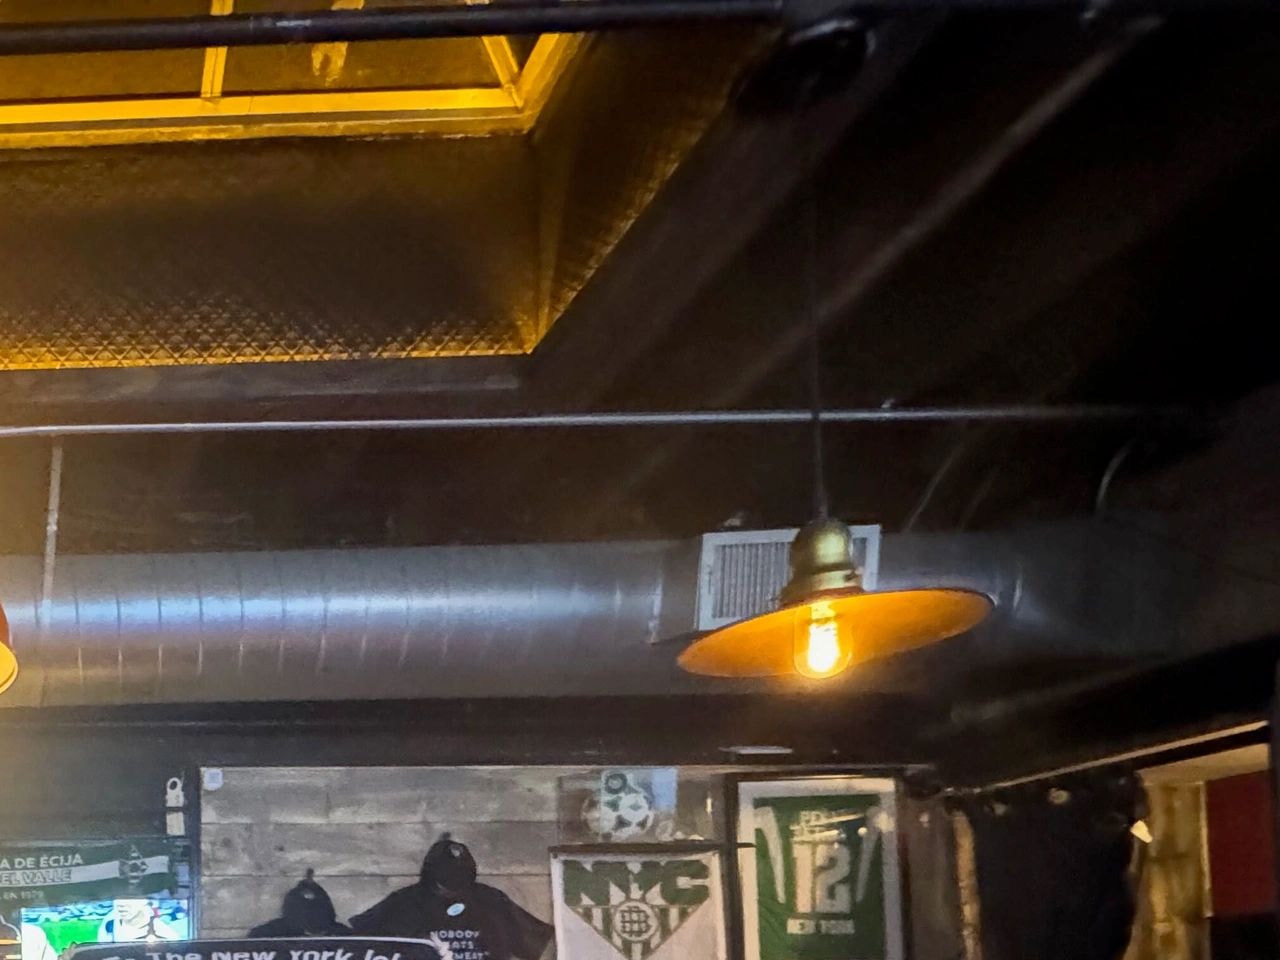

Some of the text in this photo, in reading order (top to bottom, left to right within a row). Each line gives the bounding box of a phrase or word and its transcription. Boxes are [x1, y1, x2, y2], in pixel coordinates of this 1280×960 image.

[15, 857, 34, 869] DE
[23, 868, 72, 884] VALLE
[792, 842, 851, 914] 12
[563, 860, 710, 907] NYC
